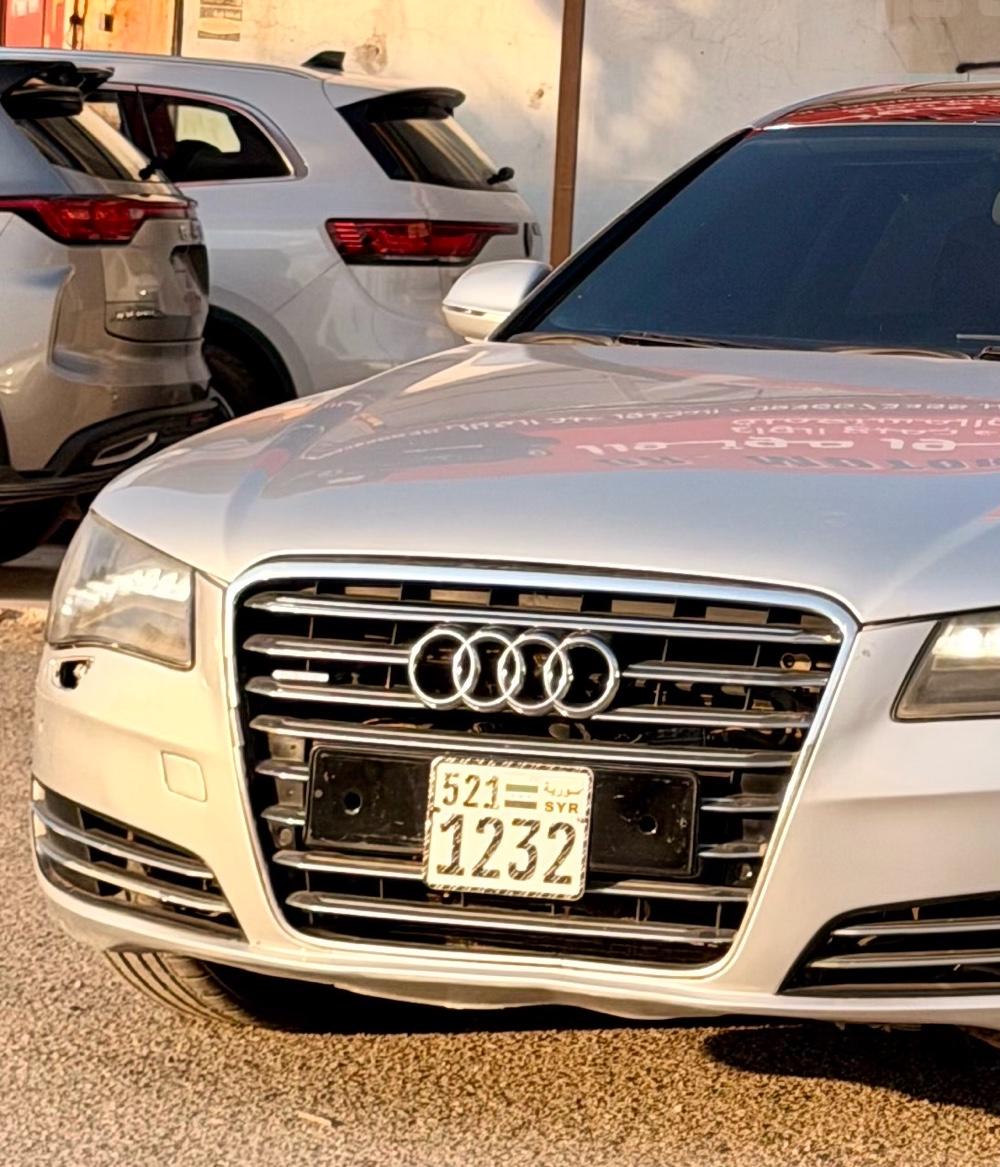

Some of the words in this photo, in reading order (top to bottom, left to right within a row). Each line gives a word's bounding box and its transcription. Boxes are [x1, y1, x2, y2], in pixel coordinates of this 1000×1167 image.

[441, 771, 500, 810] 521
[544, 801, 579, 814] SYR
[436, 813, 577, 885] 1232
